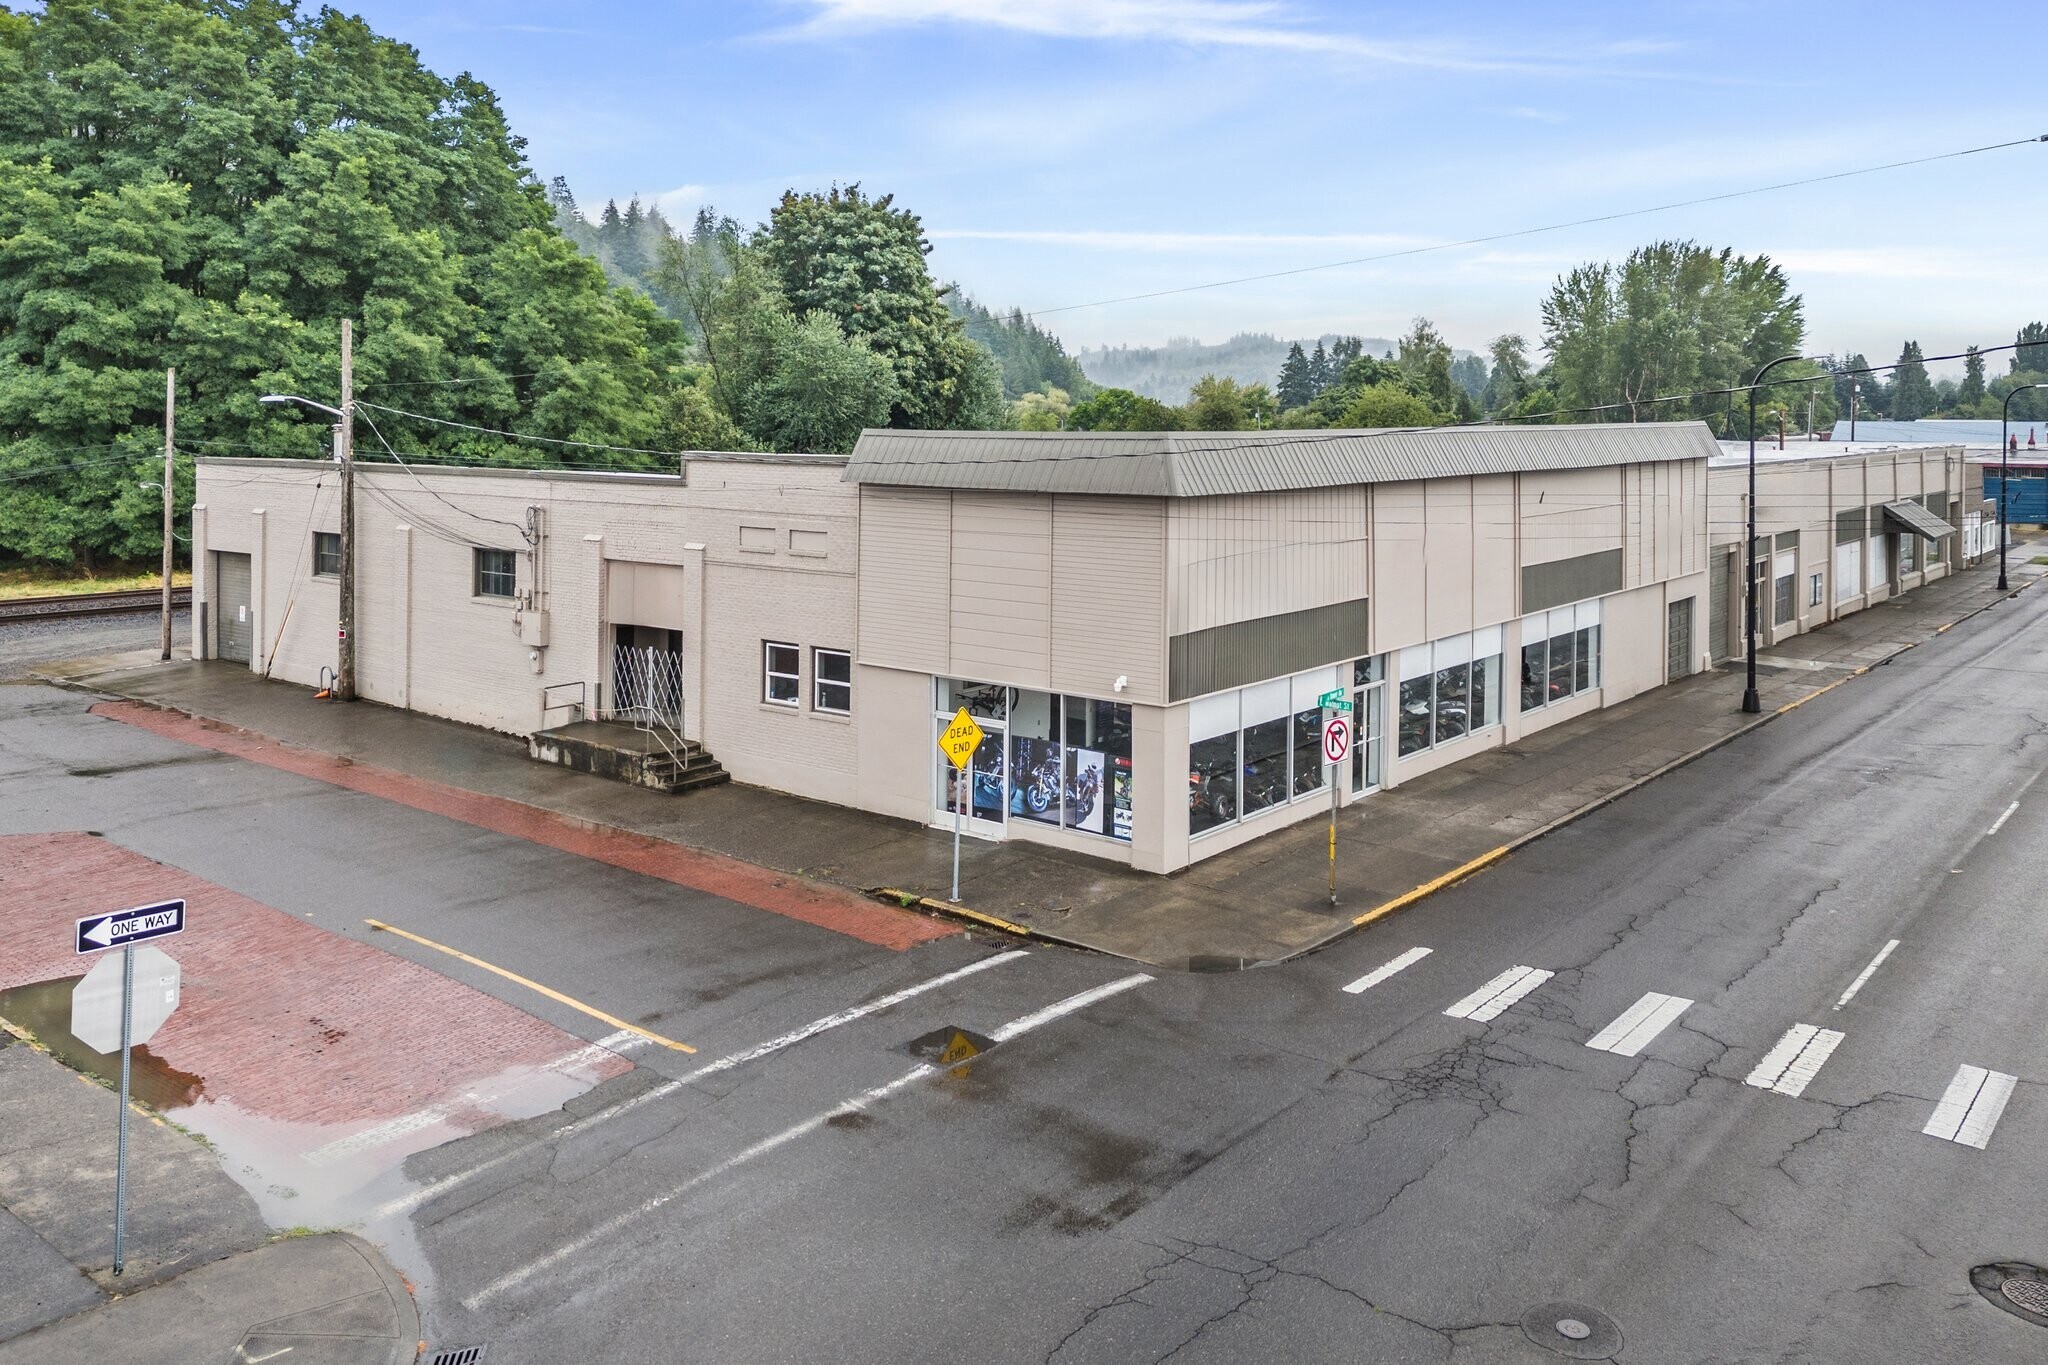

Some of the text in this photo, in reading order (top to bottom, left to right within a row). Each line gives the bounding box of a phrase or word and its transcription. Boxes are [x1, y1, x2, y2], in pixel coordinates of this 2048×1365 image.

[950, 725, 974, 739] DEAD
[953, 741, 970, 754] END
[110, 912, 173, 936] ONE WAY
